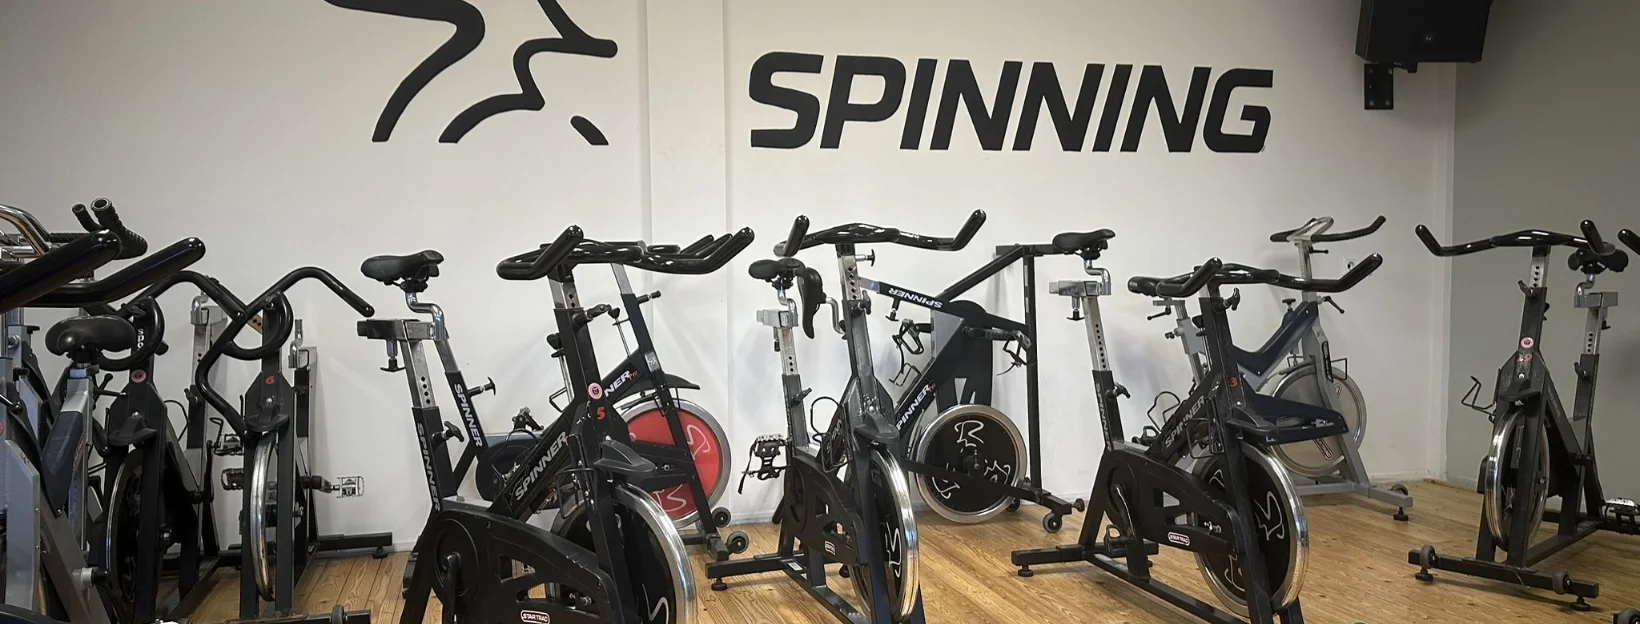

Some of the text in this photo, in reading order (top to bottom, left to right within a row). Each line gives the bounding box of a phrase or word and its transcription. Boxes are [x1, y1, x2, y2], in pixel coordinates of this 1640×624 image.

[749, 51, 1274, 154] SPINNING
[888, 287, 944, 309] SPINNER
[265, 375, 276, 385] 6
[1230, 376, 1238, 388] 3
[454, 383, 483, 447] SPINNER
[596, 406, 607, 420] 5
[896, 384, 930, 431] PINNER
[1165, 395, 1204, 448] SPINNER
[417, 422, 441, 512] SPINNER
[515, 431, 567, 501] SPINNER
